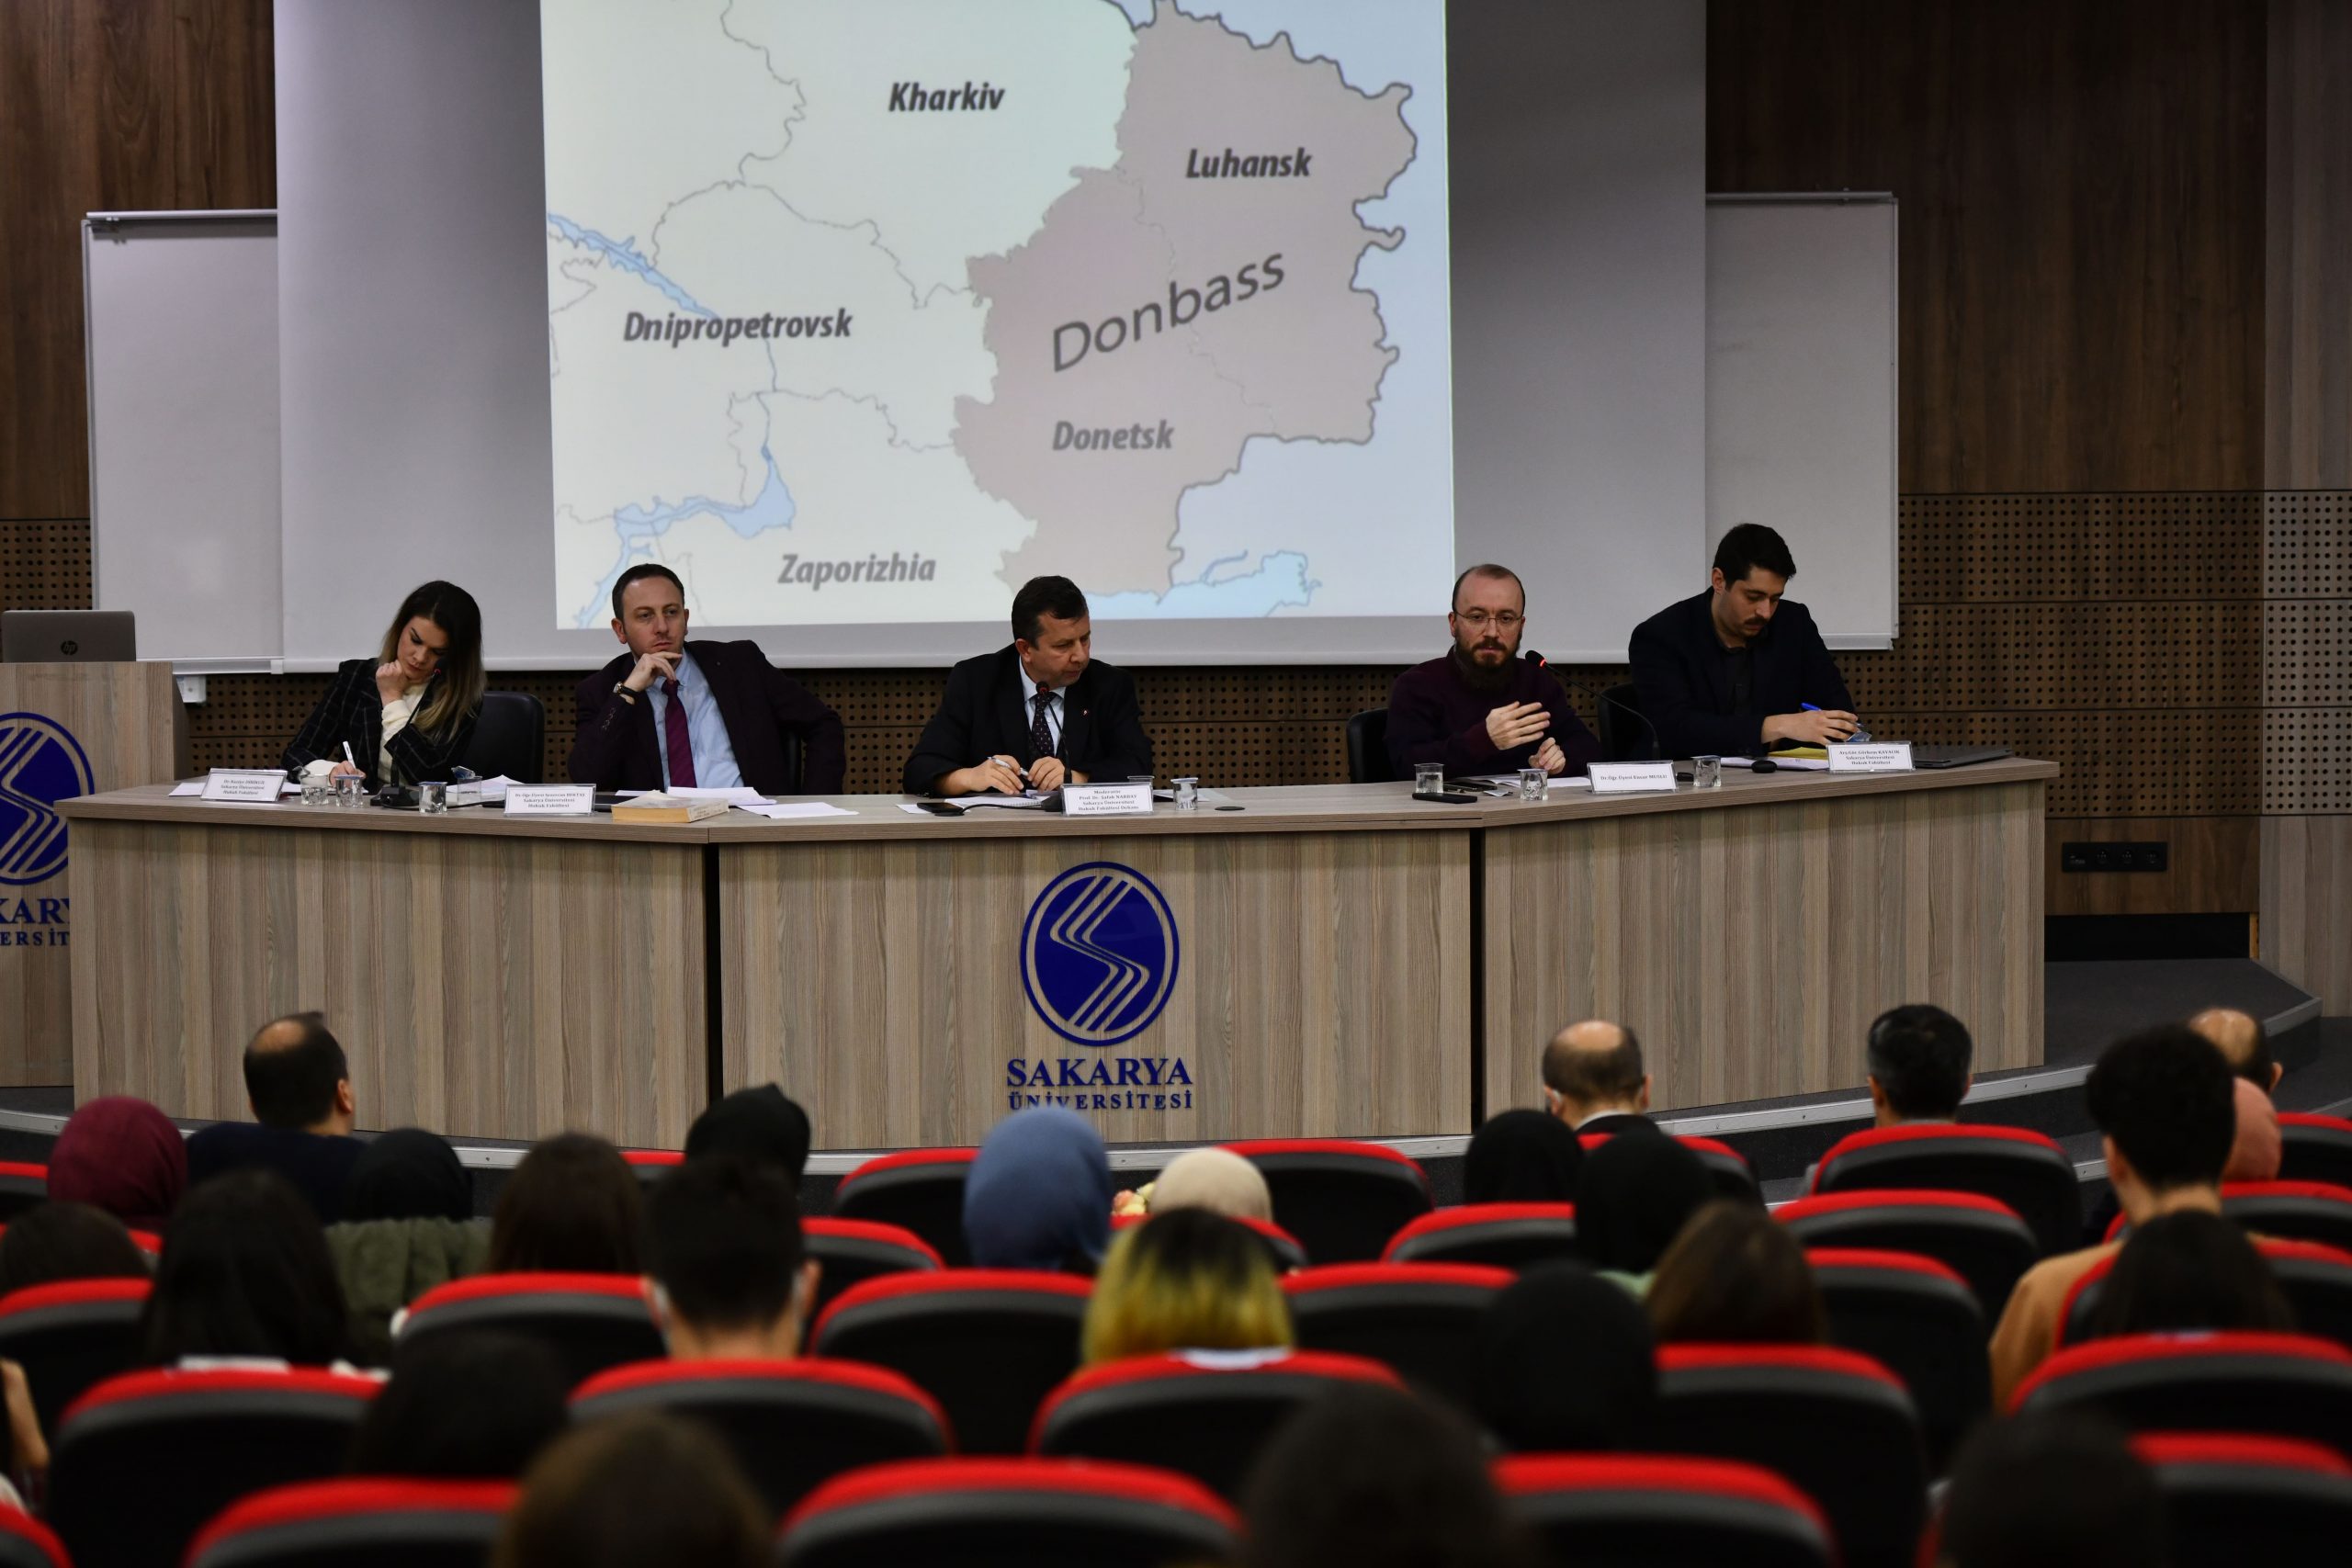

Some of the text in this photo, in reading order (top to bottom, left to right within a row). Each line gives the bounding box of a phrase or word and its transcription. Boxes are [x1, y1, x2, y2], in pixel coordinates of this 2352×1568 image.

[888, 81, 1006, 112] Kharkiv
[1185, 146, 1313, 179] Luhansk
[623, 307, 854, 348] Dnipropetrovsk
[1051, 253, 1285, 373] Donbass
[1052, 419, 1175, 451] Donetsk
[777, 551, 937, 592] Zaporizhia
[1007, 1057, 1193, 1087] SAKARYA
[1008, 1090, 1193, 1110] ÜNİVERSİTESİ
